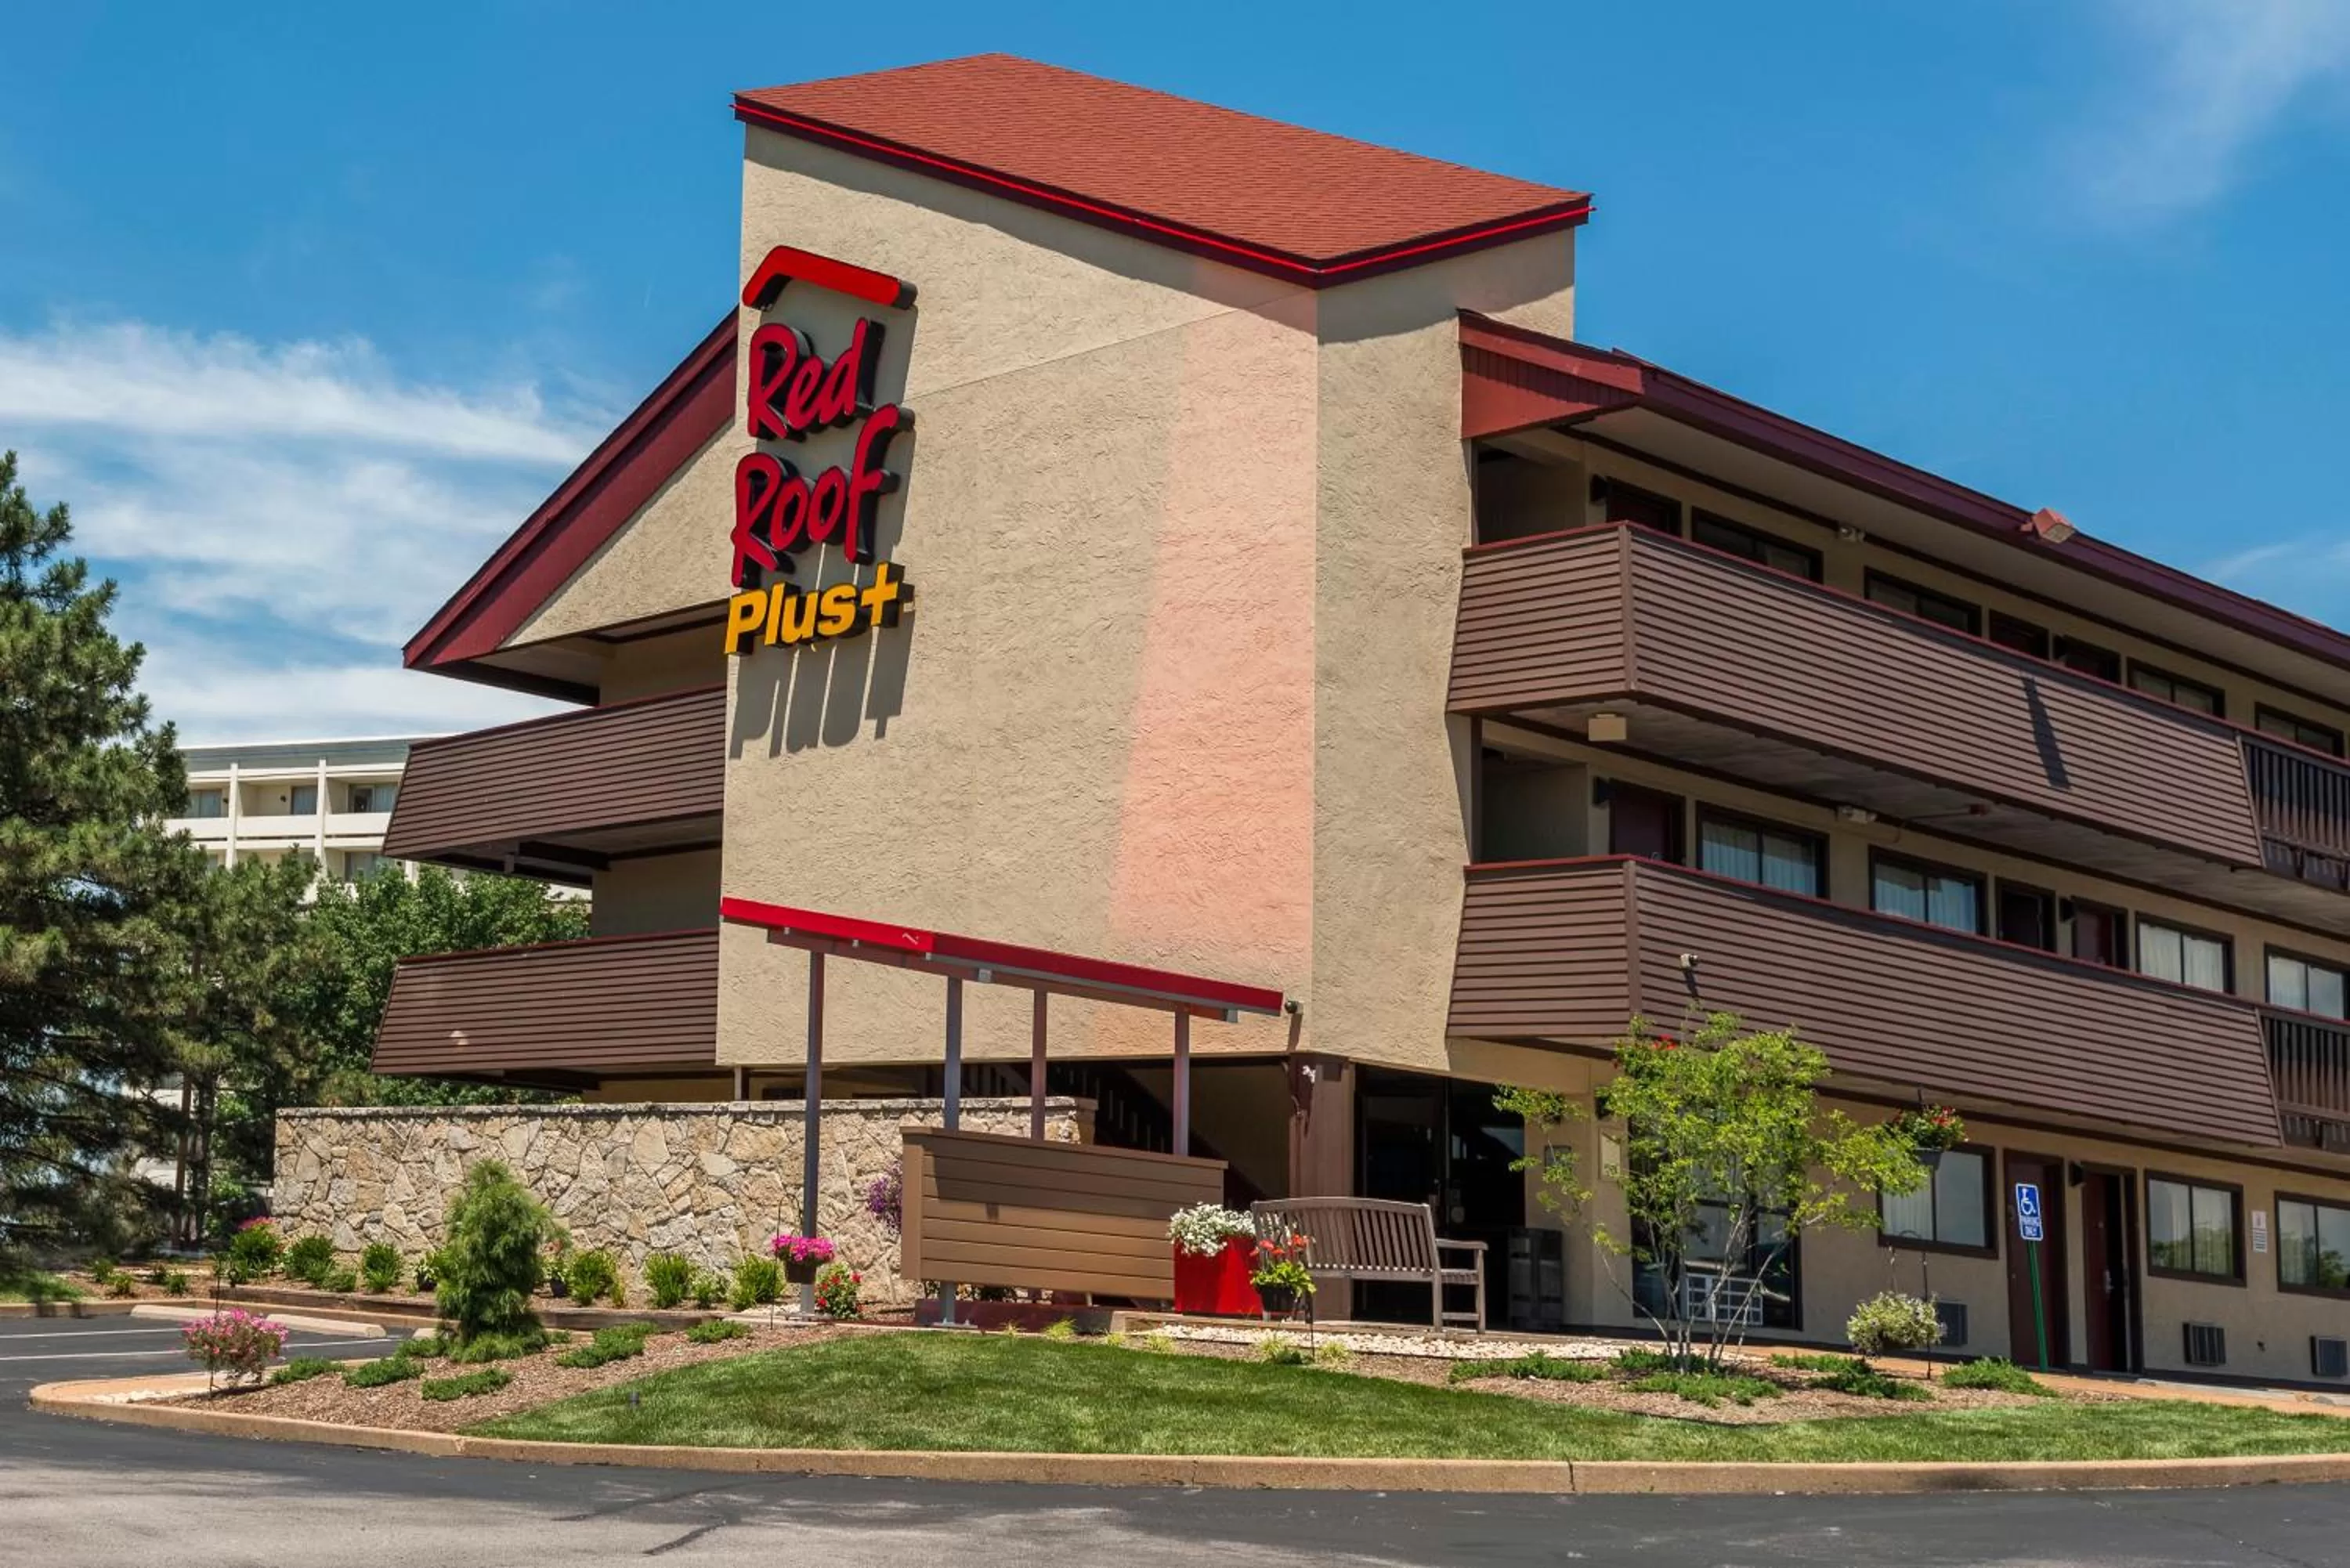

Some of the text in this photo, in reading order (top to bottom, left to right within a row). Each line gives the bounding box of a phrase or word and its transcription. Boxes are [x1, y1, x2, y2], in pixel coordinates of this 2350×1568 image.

[747, 316, 876, 440] Red
[730, 403, 902, 587] Roof
[724, 562, 904, 655] Plus+
